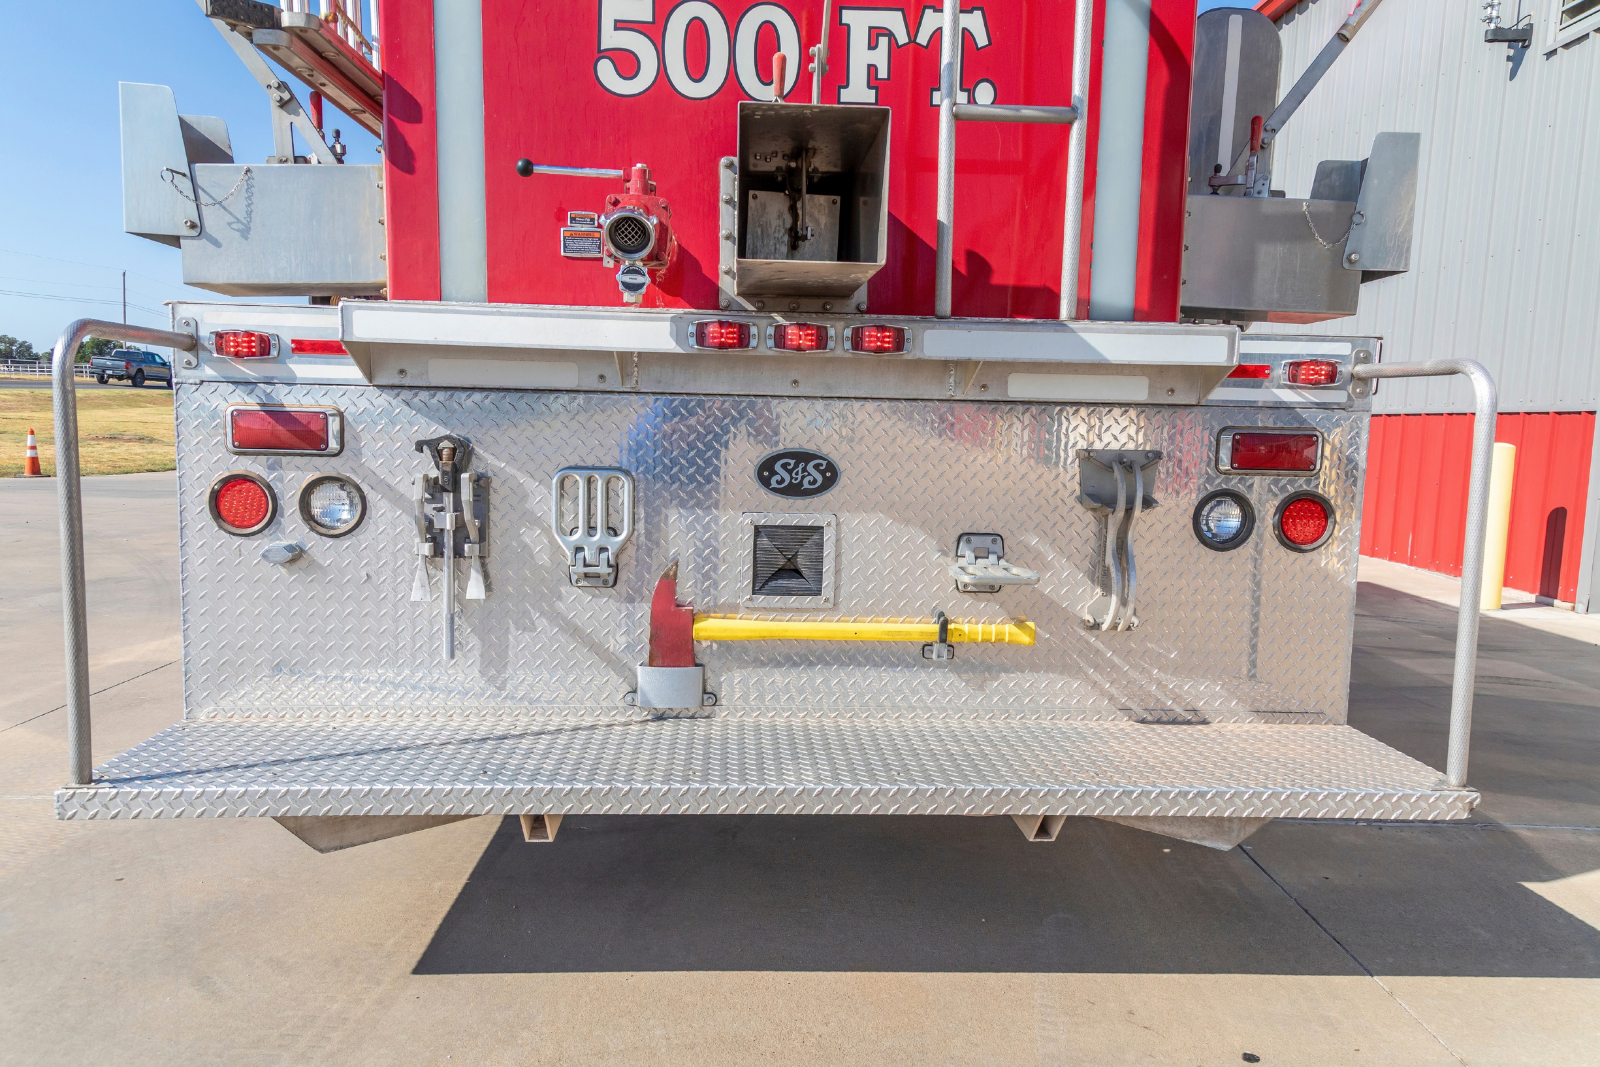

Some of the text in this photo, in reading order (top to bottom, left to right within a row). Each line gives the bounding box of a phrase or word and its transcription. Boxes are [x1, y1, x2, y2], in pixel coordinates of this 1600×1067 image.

[594, 0, 997, 107] 500 FT.
[769, 458, 828, 490] S&S
